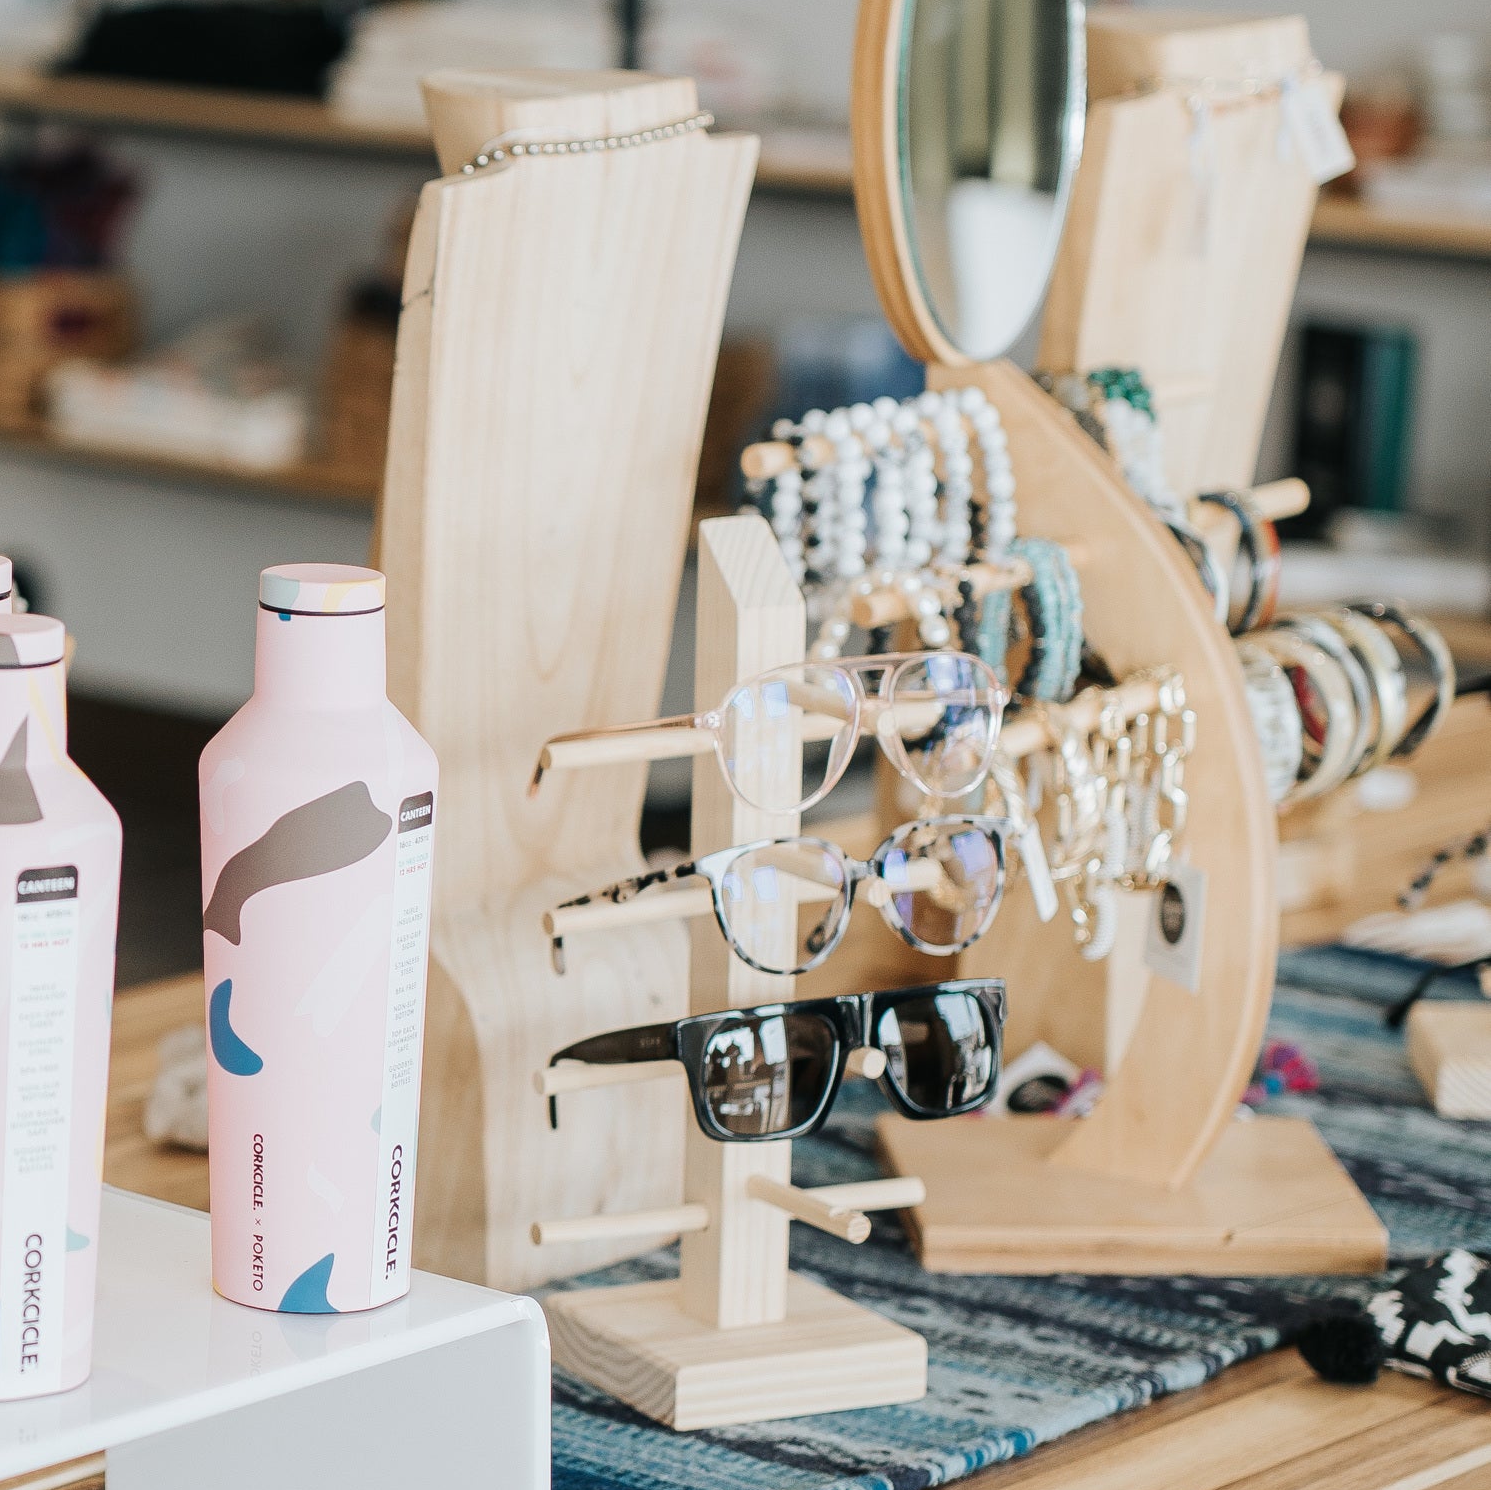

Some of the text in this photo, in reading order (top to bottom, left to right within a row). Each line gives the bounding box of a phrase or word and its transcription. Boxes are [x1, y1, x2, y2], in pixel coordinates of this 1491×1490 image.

[400, 804, 431, 823] CANTEEN
[18, 876, 75, 895] CANTEEN
[385, 1144, 403, 1281] CORKCICLE.
[252, 1234, 264, 1292] POKETO
[20, 1234, 43, 1373] CORKCICLE.
